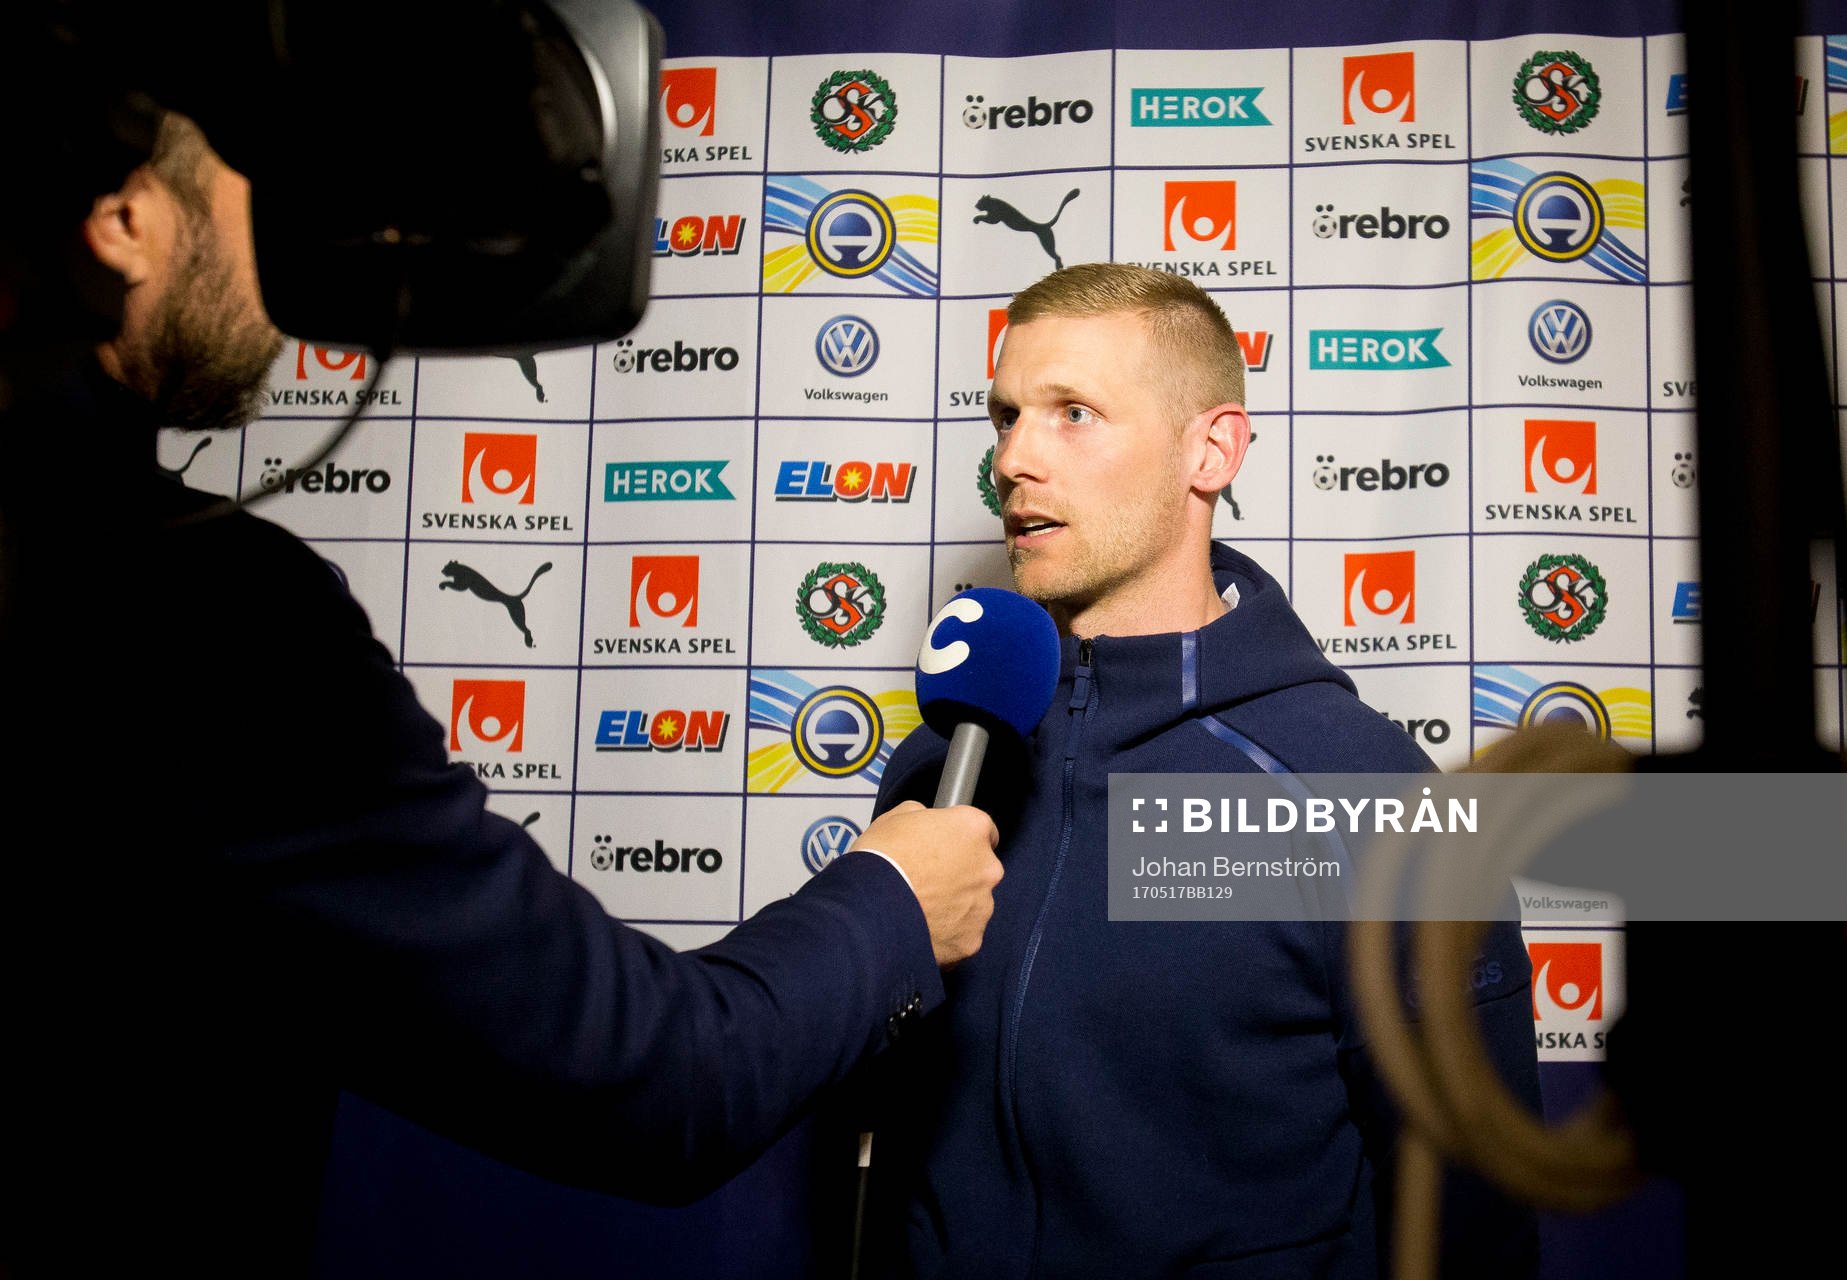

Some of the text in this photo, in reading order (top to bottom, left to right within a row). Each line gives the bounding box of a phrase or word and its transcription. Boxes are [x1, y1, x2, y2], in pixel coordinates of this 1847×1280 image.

[1140, 95, 1251, 120] HEROK
[1304, 133, 1457, 152] SVENSKA SPEL
[706, 146, 753, 162] SPEL
[652, 214, 747, 258] LON
[1227, 261, 1278, 277] SPEL
[1318, 337, 1426, 363] HEROK
[1518, 374, 1603, 391] Volkswagen
[271, 390, 402, 405] VENSKA SPEL
[804, 388, 889, 404] Volkswagen
[612, 469, 713, 495] HEROK
[774, 460, 918, 505] ELON
[421, 512, 574, 532] SVENSKA SPEL
[1485, 503, 1638, 524] SVENSKA SPEL
[593, 638, 737, 655] SVENSKA SPEL
[1318, 633, 1458, 654] VENSKA SPEL
[594, 709, 731, 753] ELON
[512, 762, 562, 780] SPEL
[1522, 896, 1609, 912] Volkswagen
